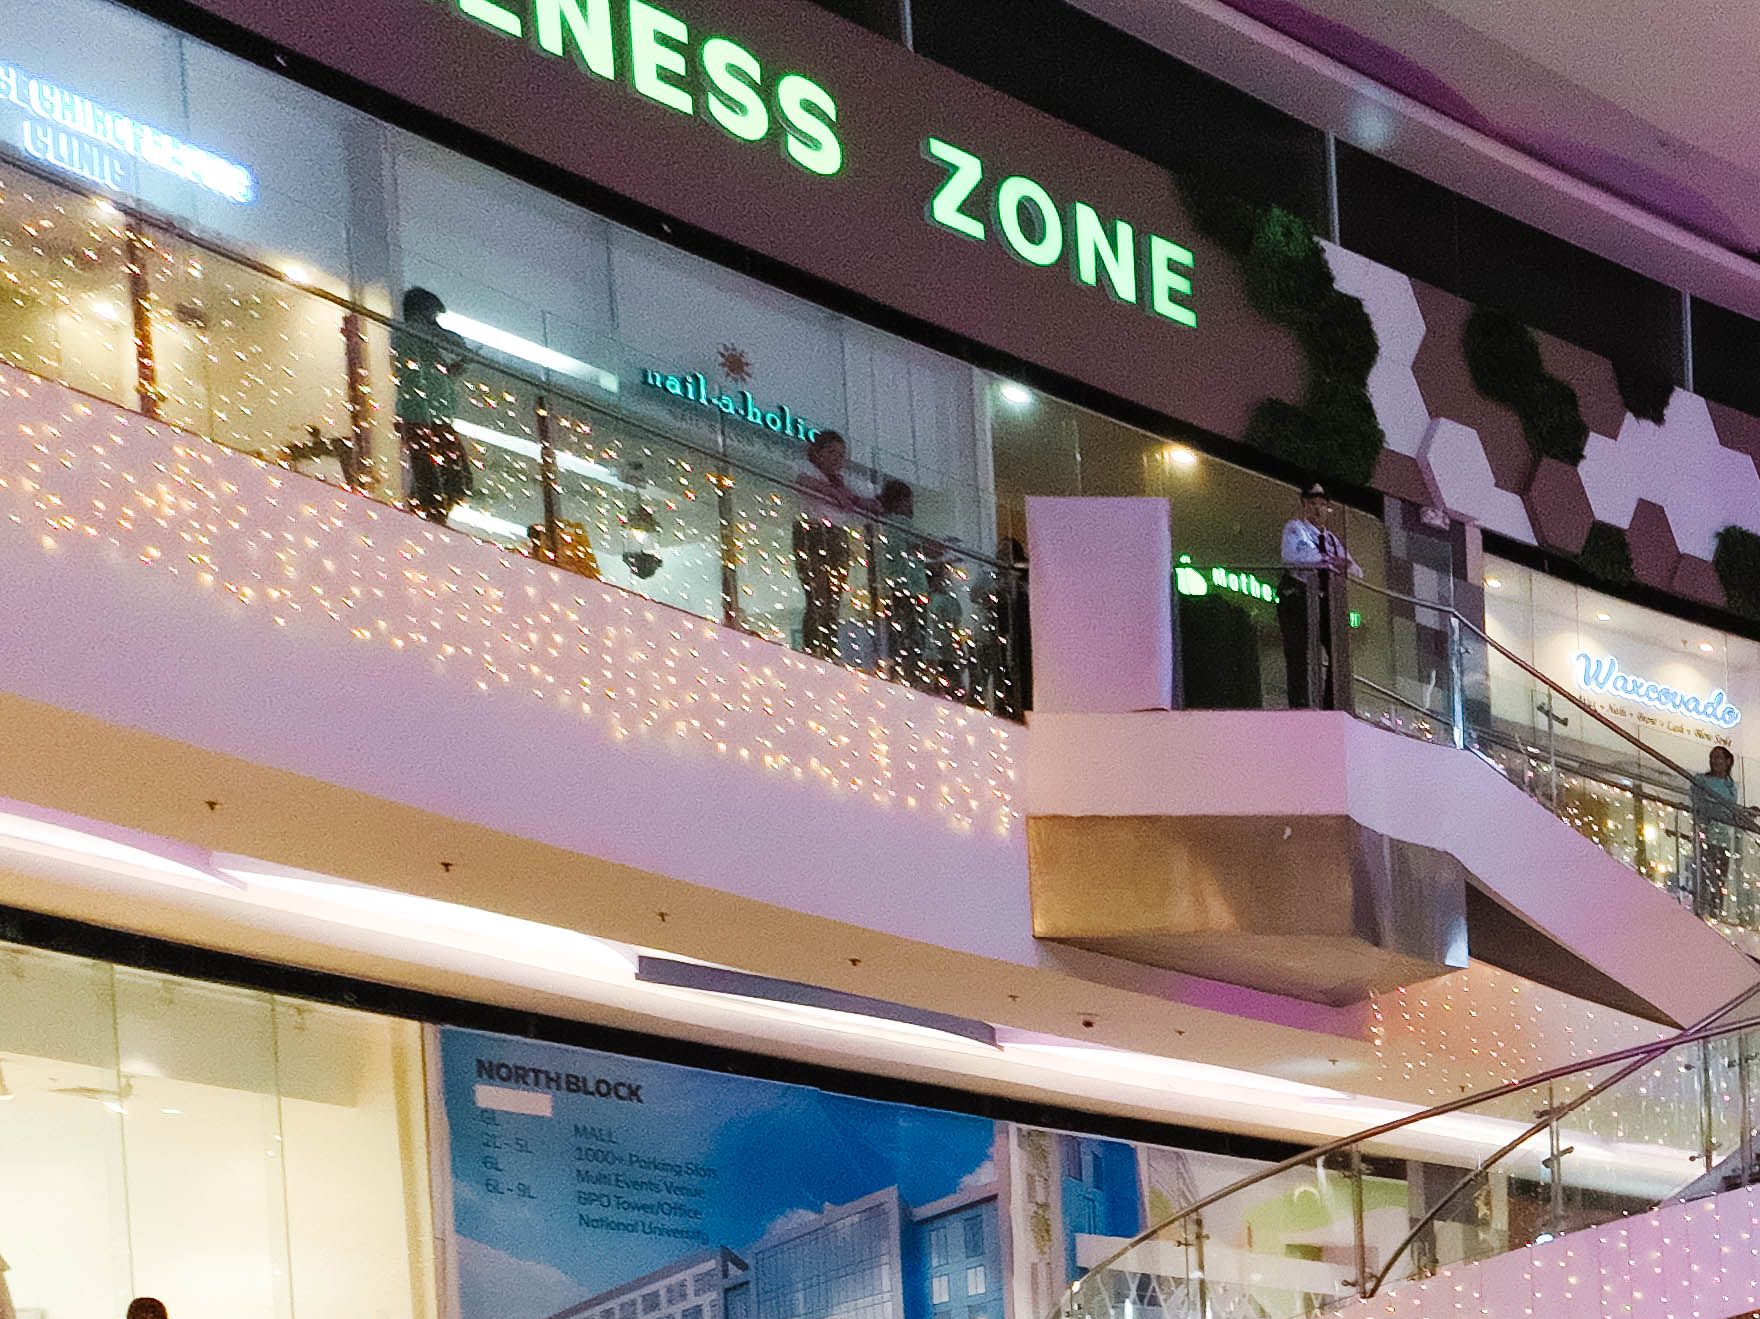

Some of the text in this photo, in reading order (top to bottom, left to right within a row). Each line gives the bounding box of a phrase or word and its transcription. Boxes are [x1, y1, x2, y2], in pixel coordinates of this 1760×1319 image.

[924, 136, 1198, 329] ZONE
[1575, 652, 1742, 728] Waxcovado
[475, 1057, 644, 1104] NORTH BLOCK
